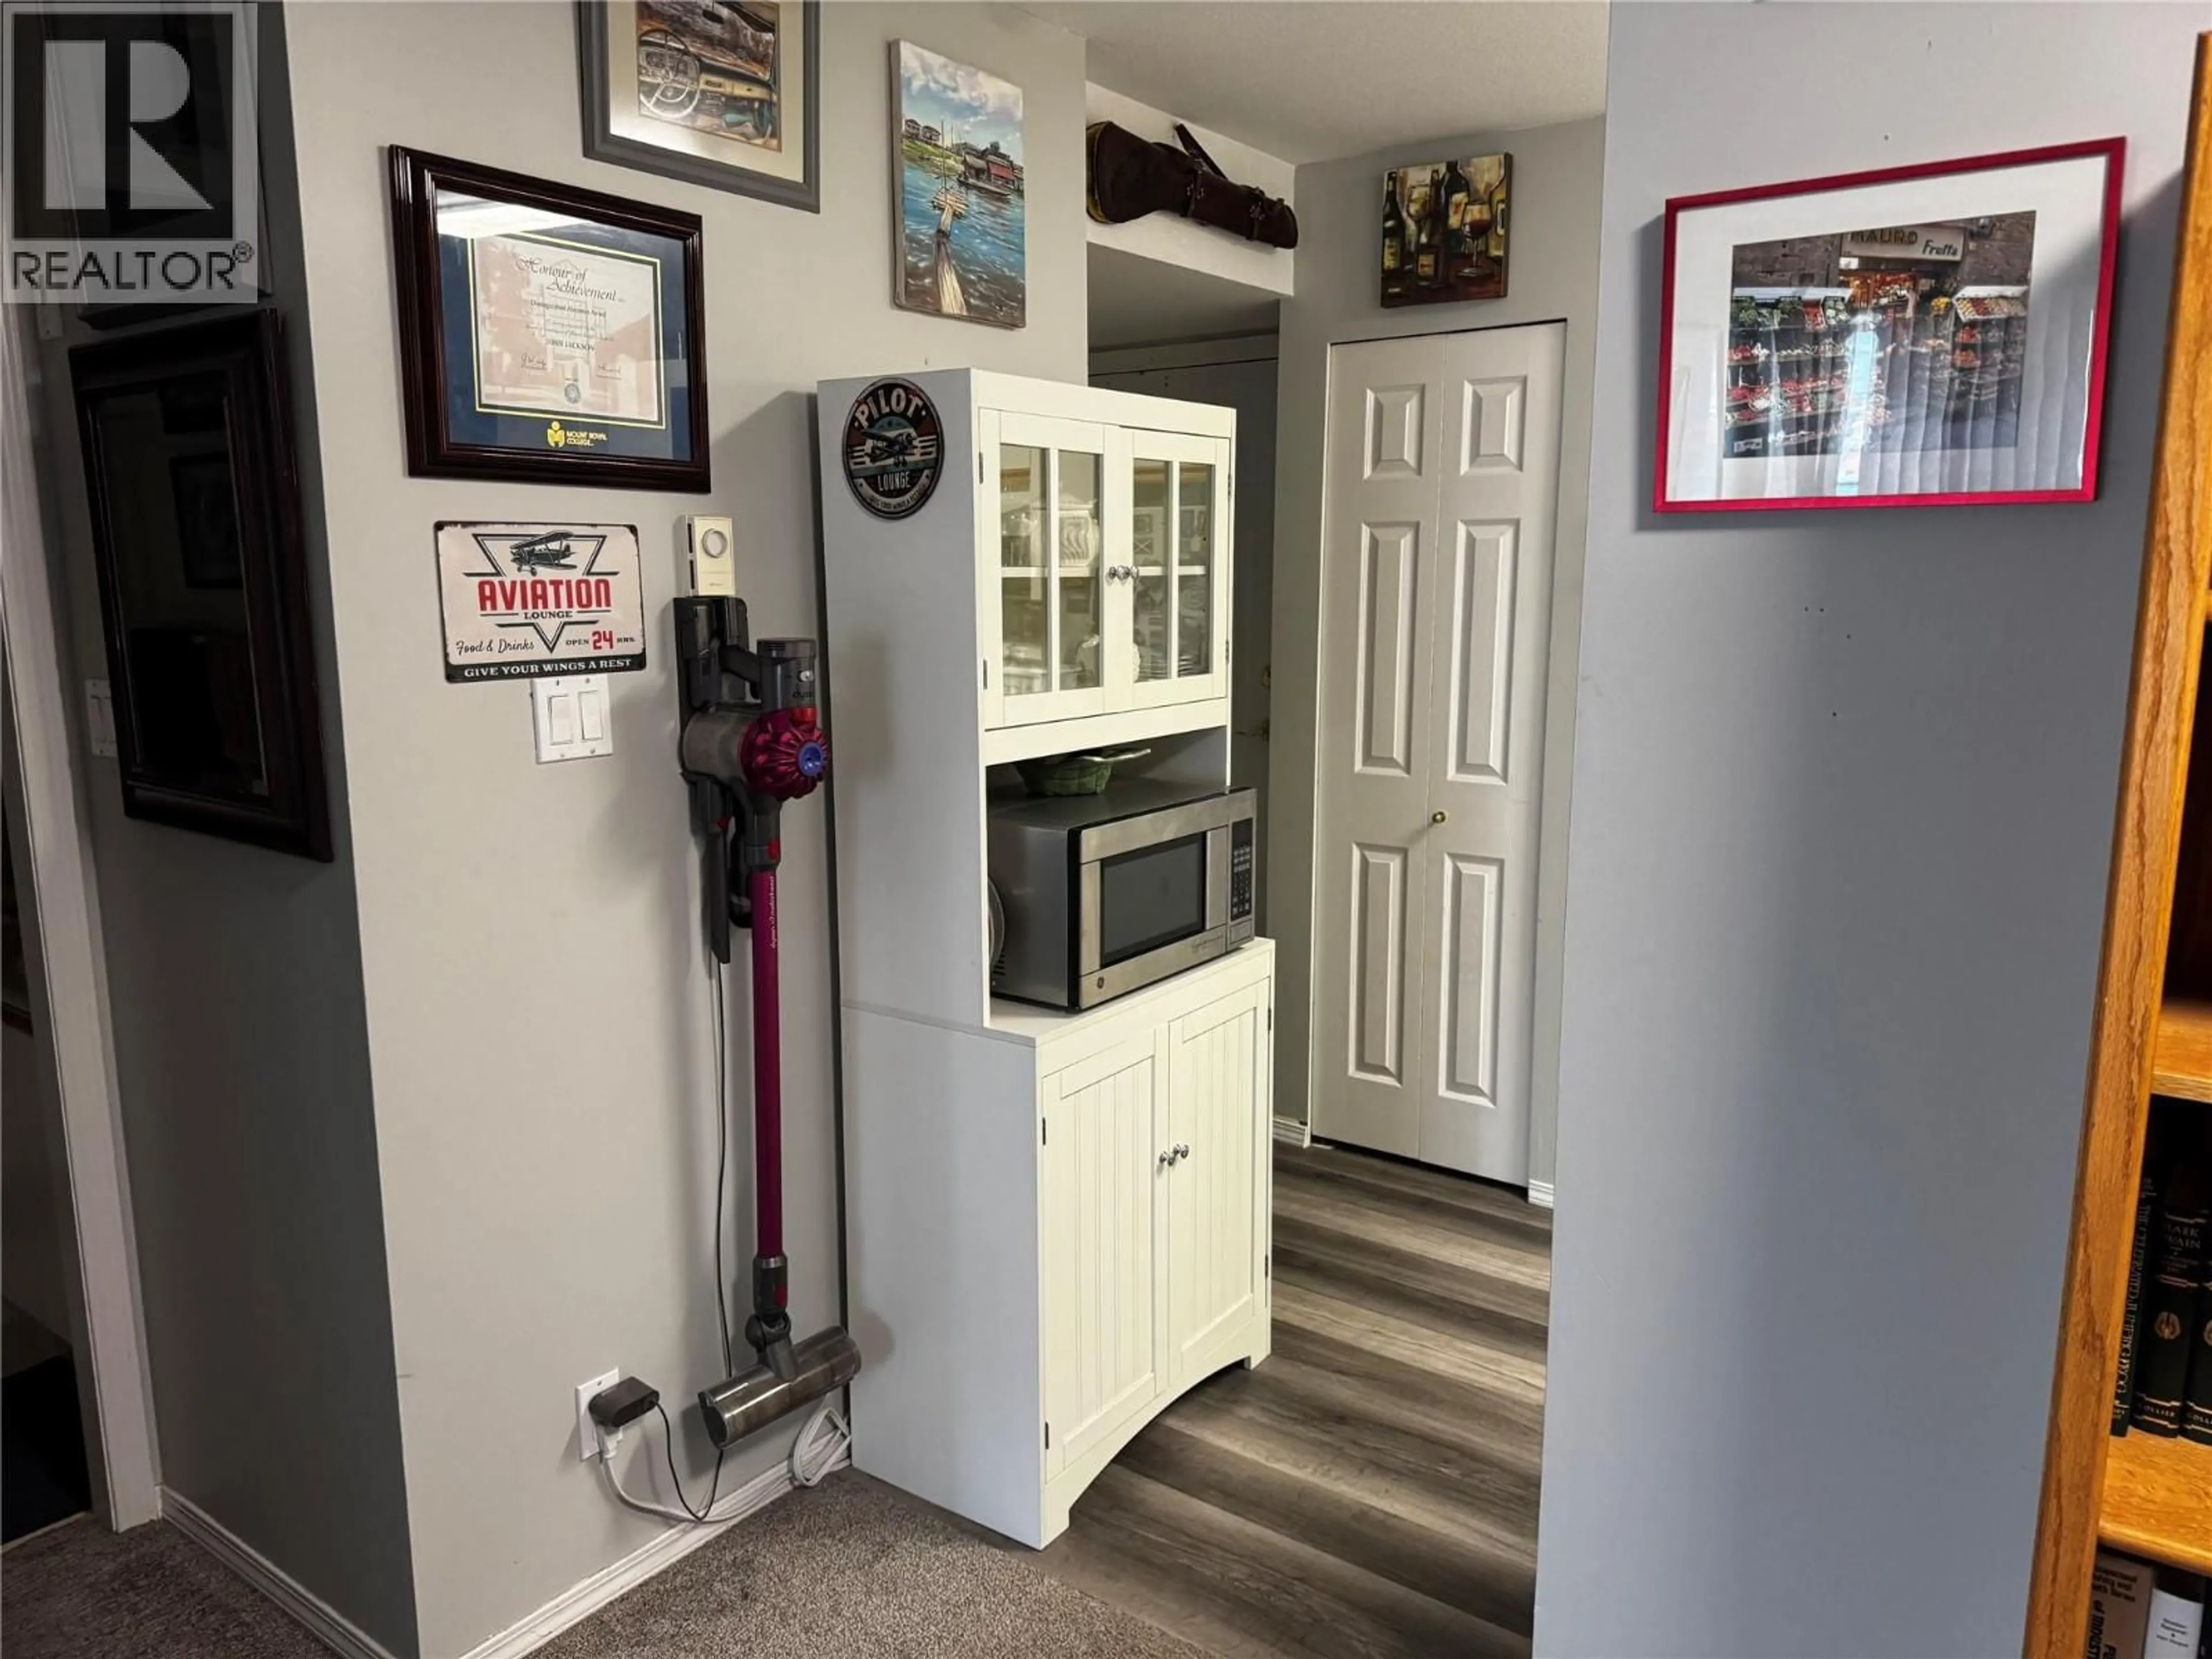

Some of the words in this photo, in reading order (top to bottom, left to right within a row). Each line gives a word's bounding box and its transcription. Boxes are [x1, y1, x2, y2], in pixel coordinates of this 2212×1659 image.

[516, 256, 572, 278] Honour
[575, 267, 589, 282] of
[546, 278, 616, 301] Achievement
[855, 388, 924, 429] PILOT
[877, 471, 911, 491] LOUNGE
[478, 578, 612, 611] AVIATION
[524, 611, 573, 620] LOUNGE
[456, 639, 483, 656] Food
[486, 639, 494, 652] &
[498, 639, 535, 653] Drinks
[592, 631, 613, 650] 24
[464, 667, 499, 677] GIVE
[502, 664, 540, 675] YOUR
[543, 662, 586, 673] WINGS
[587, 661, 597, 669] A
[600, 658, 632, 668] REST
